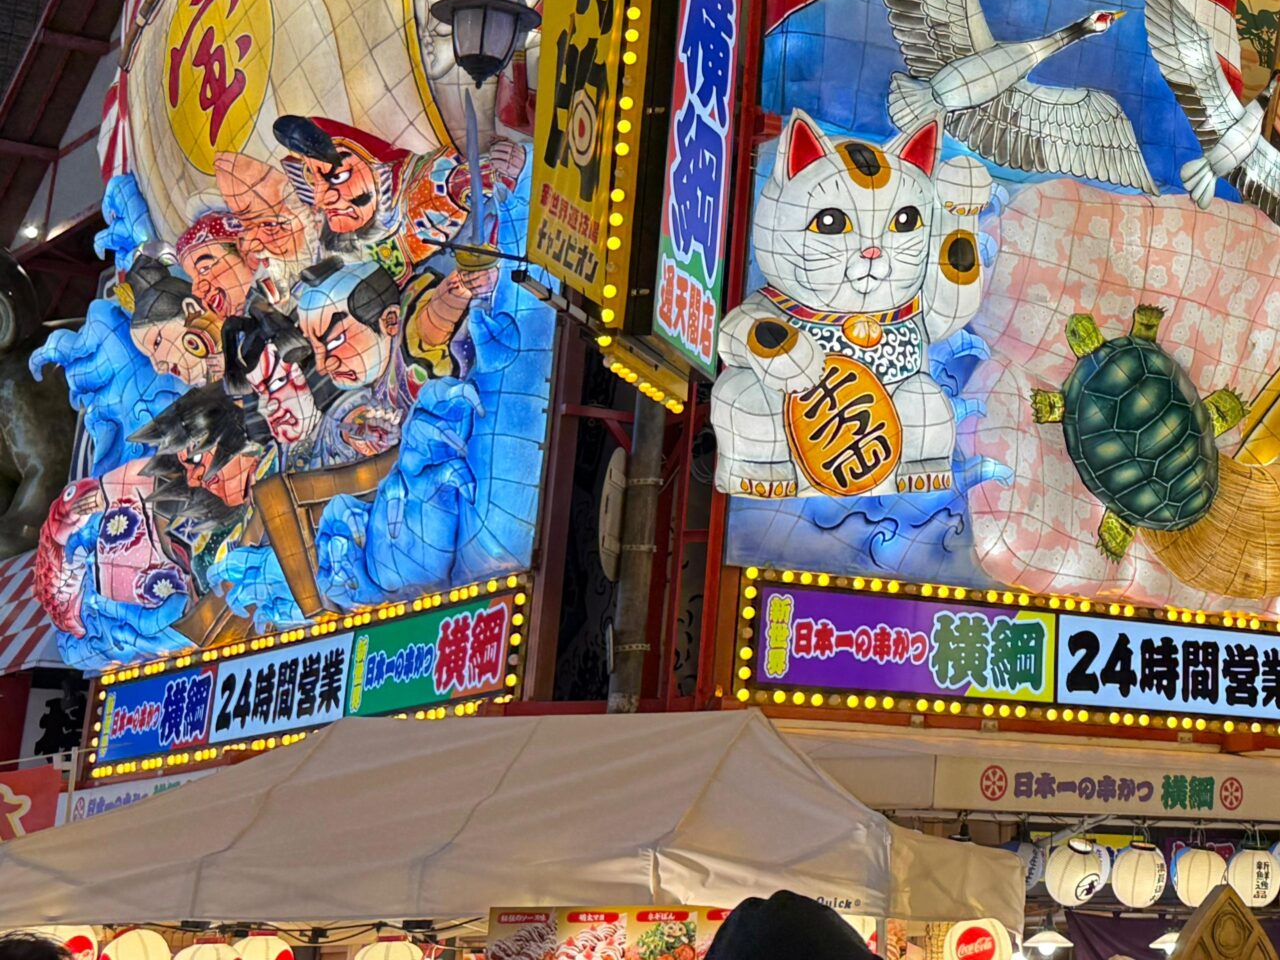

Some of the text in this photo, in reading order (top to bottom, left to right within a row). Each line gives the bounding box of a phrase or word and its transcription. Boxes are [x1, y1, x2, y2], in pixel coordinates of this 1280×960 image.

[537, 218, 599, 284] チャンピオン
[656, 256, 717, 366] 通天閣店
[432, 603, 509, 695] 横綱
[763, 593, 1048, 693] 新世界 日本一の串かつ 横綱
[158, 671, 214, 747] 横綱
[214, 646, 348, 732] 24時間営業
[1014, 771, 1216, 811] 日本一の串かつ 横綱
